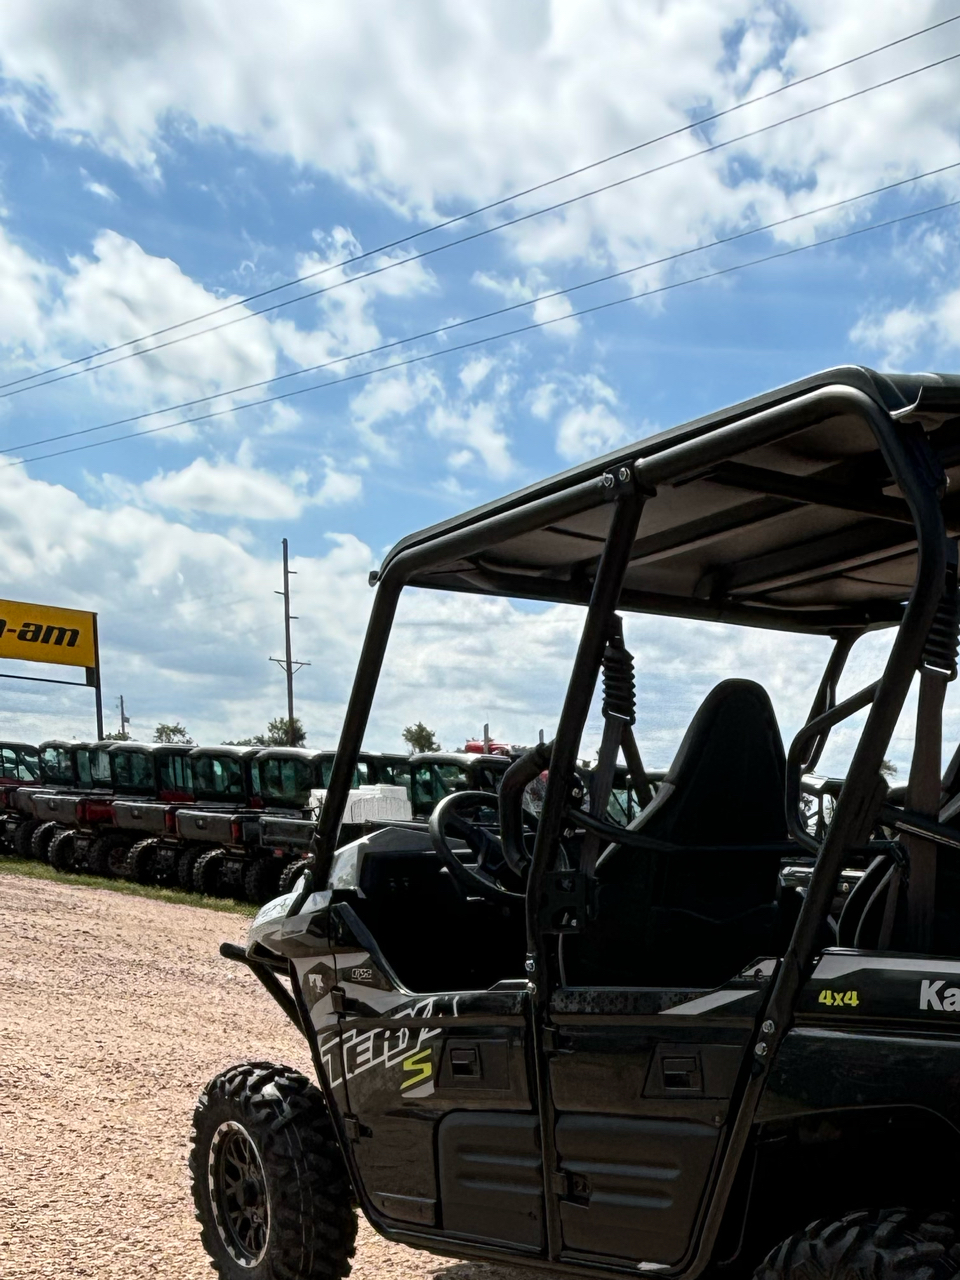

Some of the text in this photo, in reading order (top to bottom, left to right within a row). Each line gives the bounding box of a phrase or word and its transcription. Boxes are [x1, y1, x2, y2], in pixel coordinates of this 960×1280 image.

[0, 618, 80, 648] -am
[818, 990, 860, 1007] 4x4
[400, 1048, 432, 1090] S
